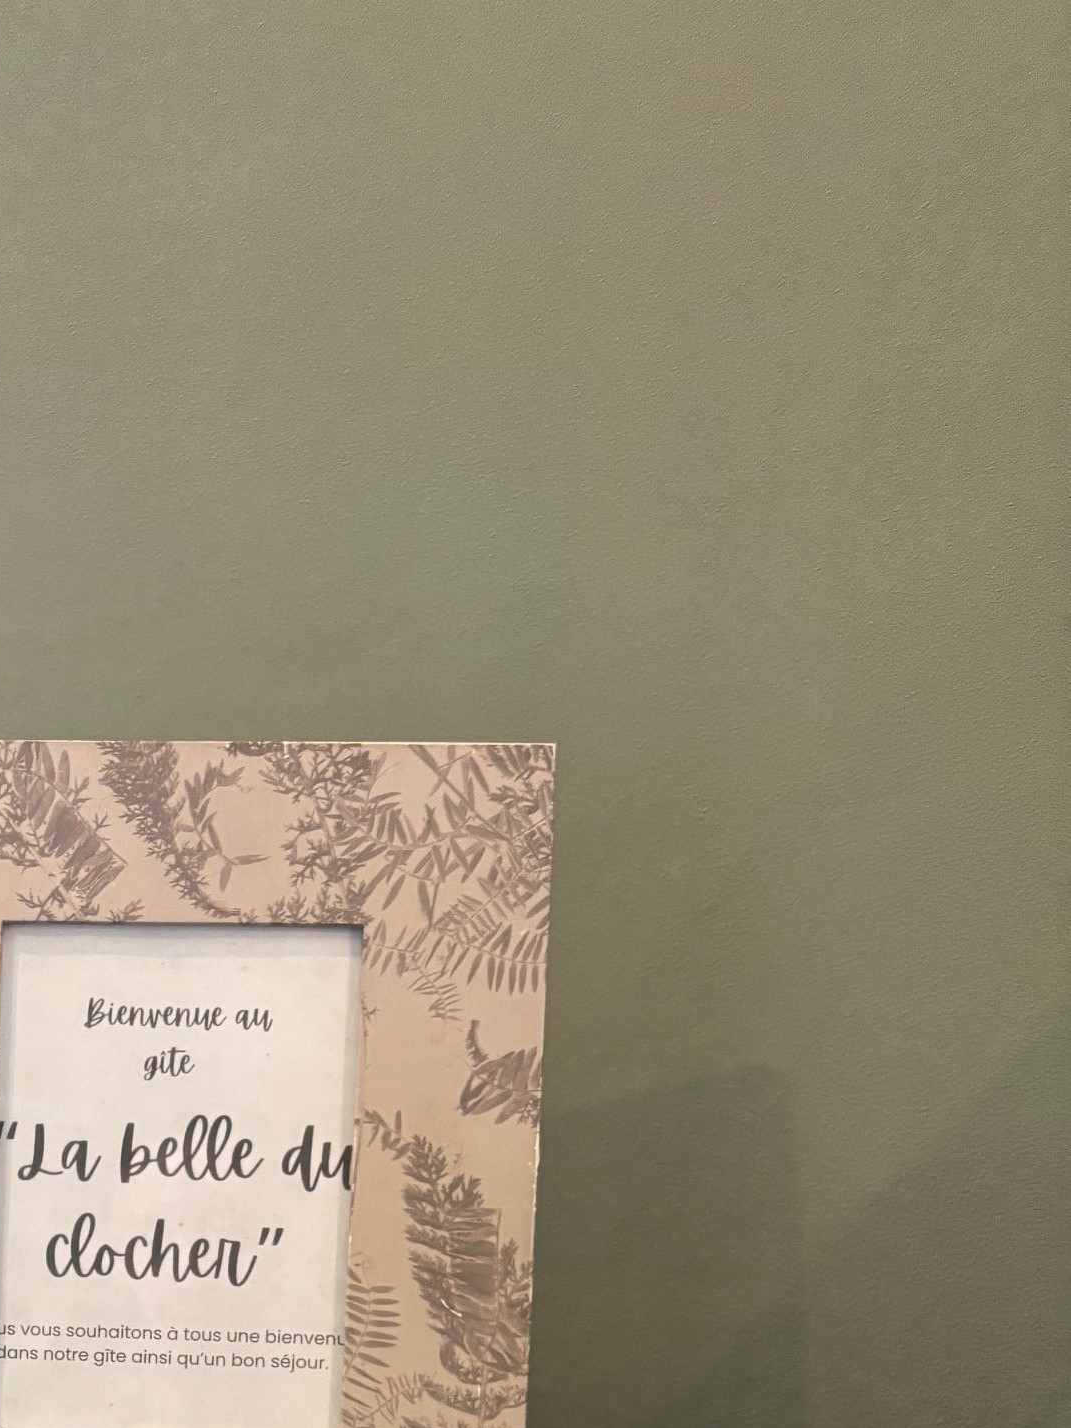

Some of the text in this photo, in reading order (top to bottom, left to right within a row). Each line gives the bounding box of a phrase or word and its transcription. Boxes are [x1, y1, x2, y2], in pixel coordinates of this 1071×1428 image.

[83, 997, 274, 1033] Bienvenue au
[143, 1046, 196, 1081] gîte
[119, 1114, 265, 1184] belle
[281, 1124, 353, 1193] du
[20, 1324, 61, 1337] vous
[65, 1324, 162, 1341] souhaitons
[166, 1325, 179, 1341] à
[183, 1327, 222, 1343] tous
[226, 1331, 260, 1344] une
[43, 1348, 89, 1362] notre
[93, 1348, 127, 1367] gîte
[131, 1349, 172, 1365] ainsi
[231, 1352, 266, 1368] bon
[270, 1353, 329, 1374] séjour.
